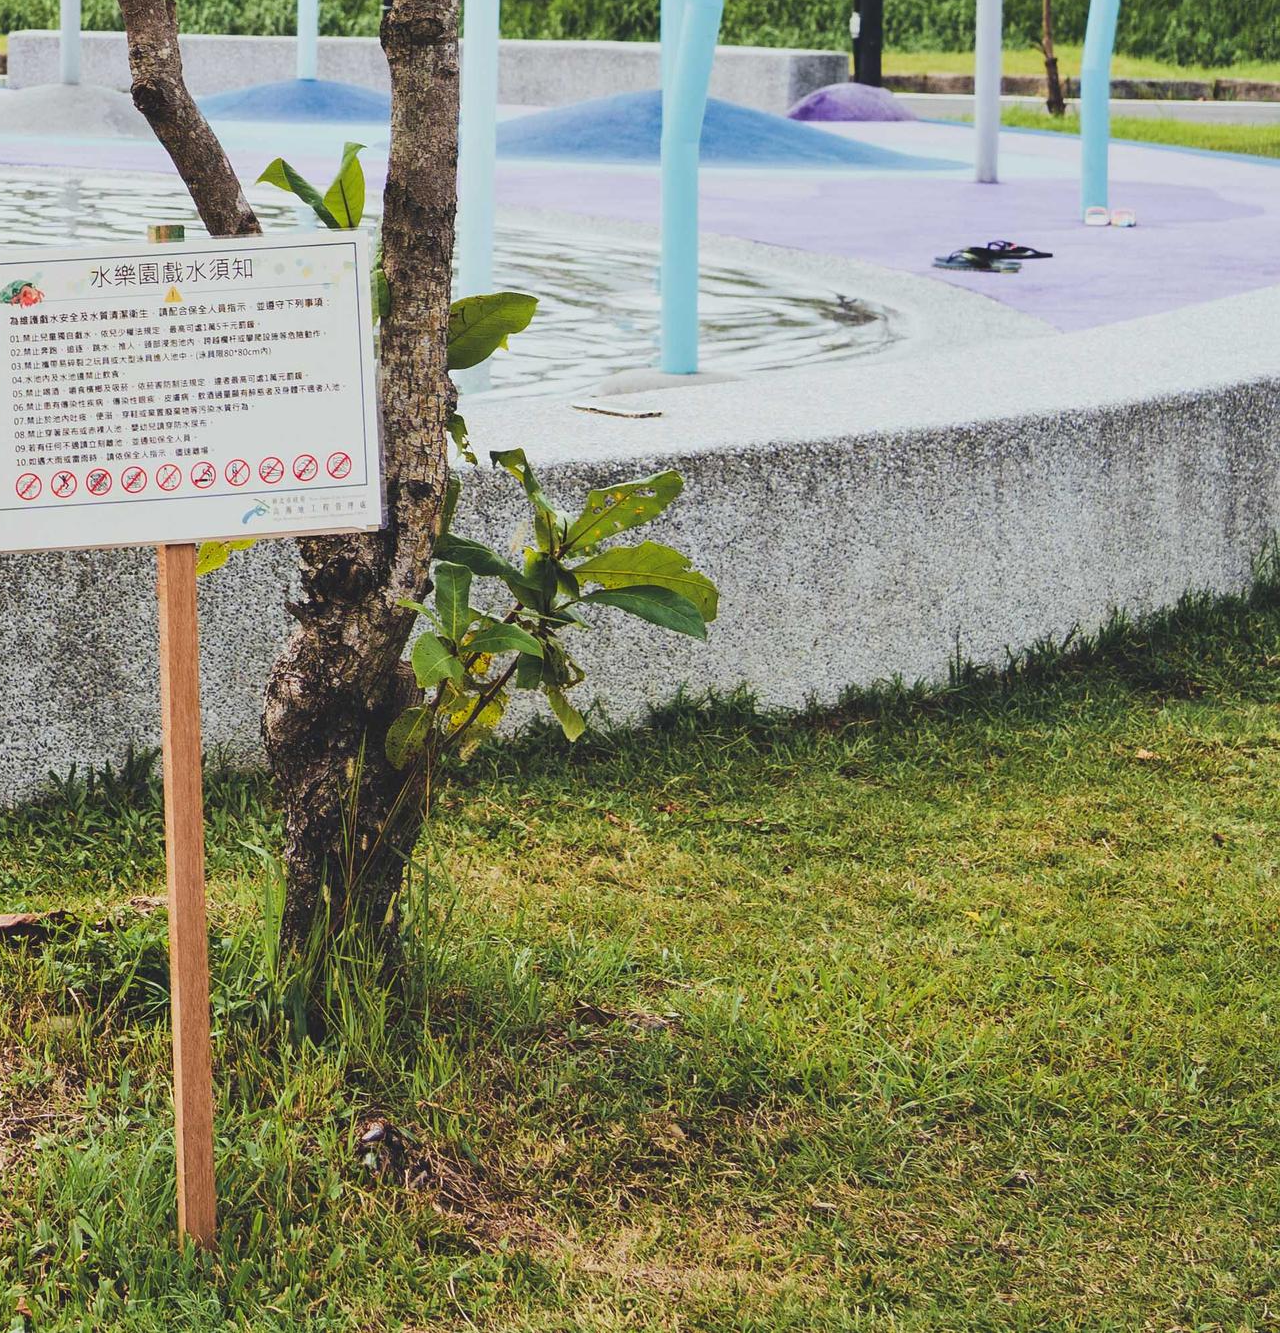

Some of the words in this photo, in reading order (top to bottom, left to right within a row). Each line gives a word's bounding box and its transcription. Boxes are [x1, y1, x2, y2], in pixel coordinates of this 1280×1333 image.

[90, 256, 253, 288] 水樂園戲水須知
